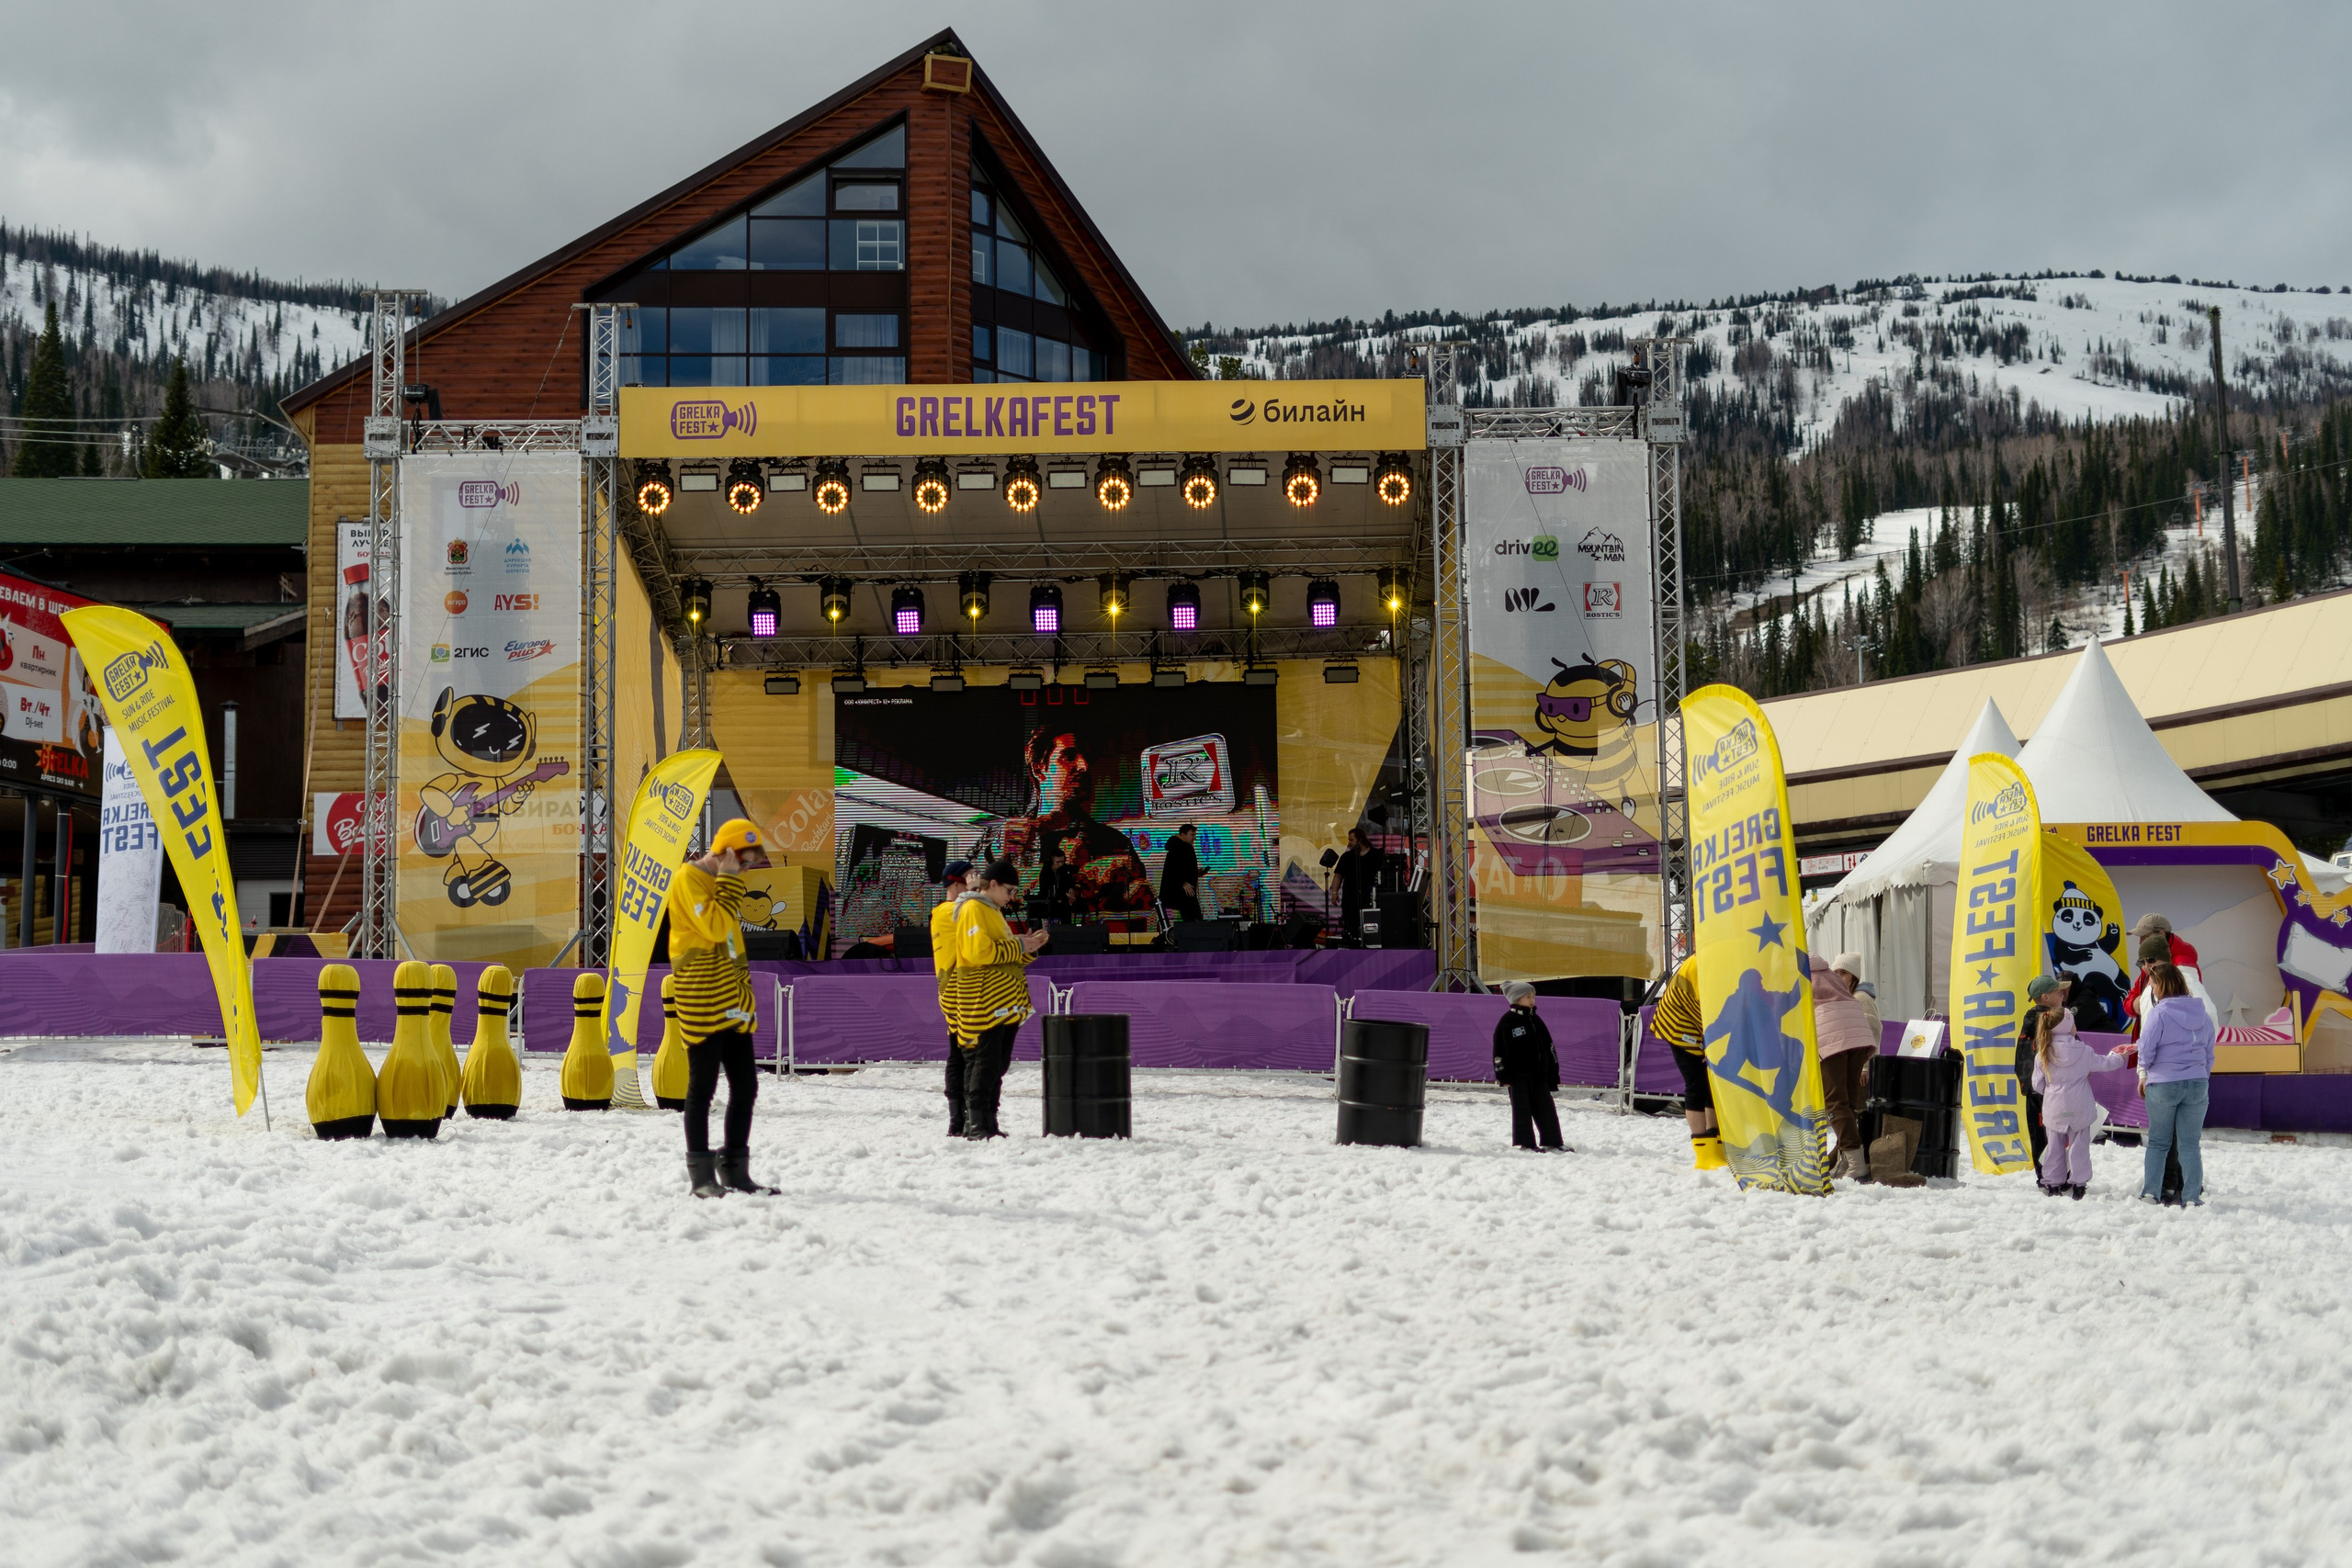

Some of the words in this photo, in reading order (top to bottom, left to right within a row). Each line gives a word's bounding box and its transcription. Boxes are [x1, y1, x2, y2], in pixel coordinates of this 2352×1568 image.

[680, 406, 719, 419] GRELKA
[897, 395, 1120, 436] GRELKAFEST
[1264, 399, 1364, 423] билайн
[680, 421, 707, 434] FEST
[1532, 470, 1560, 480] GRELKA
[465, 484, 493, 494] GRELKA
[1532, 481, 1551, 490] FEST
[465, 495, 484, 504] FEST
[1495, 540, 1559, 557] drivee
[1577, 544, 1624, 553] MOUNTAIN
[1603, 554, 1625, 562] MAN
[39, 597, 45, 611] В
[494, 593, 540, 611] AYS!
[32, 645, 47, 661] Пн.
[454, 647, 490, 659] 2ГИС
[19, 660, 57, 677] квартирник
[108, 655, 137, 683] GRELKA
[114, 673, 135, 697] FEST
[121, 702, 137, 720] SUN
[135, 700, 142, 711] &
[139, 688, 156, 707] RIDE
[128, 712, 150, 734] MUSIC
[146, 694, 176, 720] FESTIVAL
[25, 716, 44, 729] Dj-set
[40, 749, 89, 779] GRELKA
[773, 789, 830, 849] Cola
[2086, 826, 2140, 842] GRELKA
[2146, 824, 2183, 841] FEST
